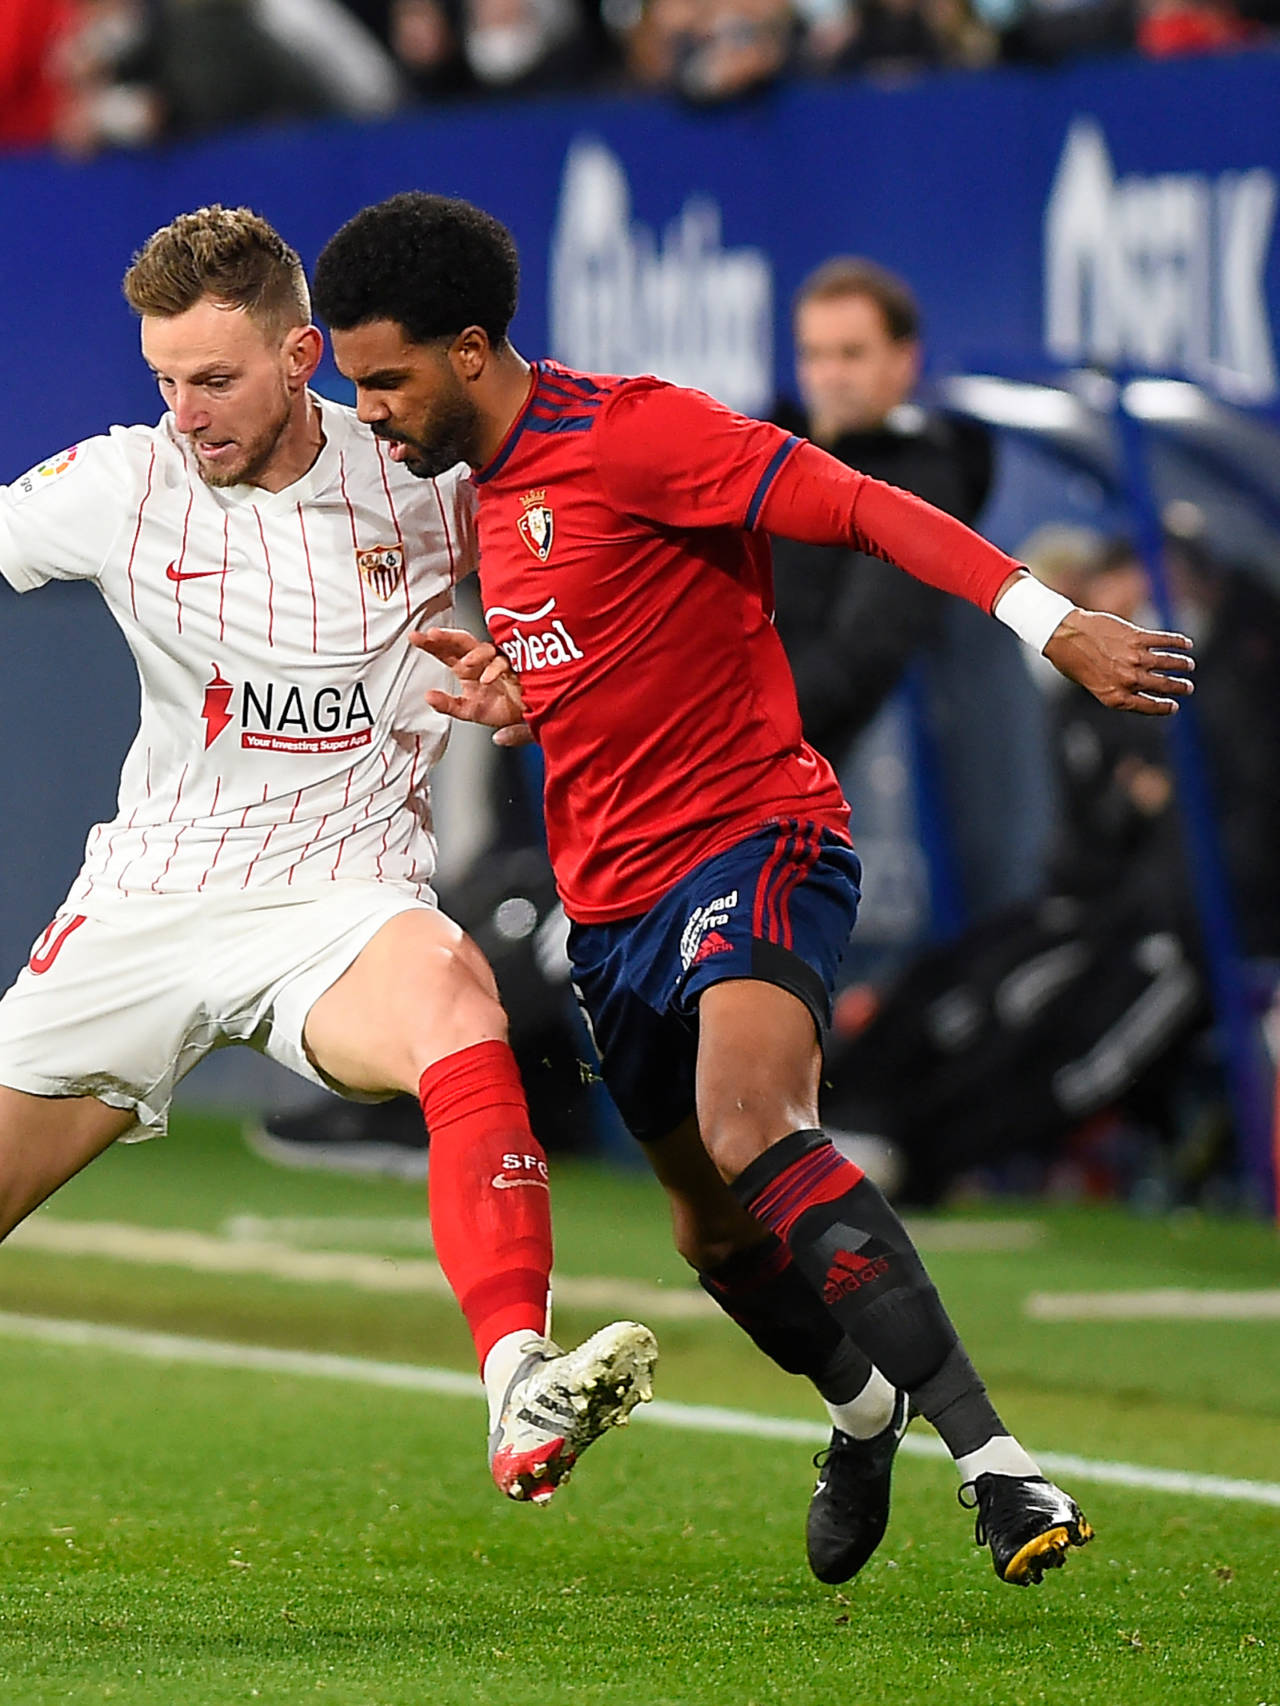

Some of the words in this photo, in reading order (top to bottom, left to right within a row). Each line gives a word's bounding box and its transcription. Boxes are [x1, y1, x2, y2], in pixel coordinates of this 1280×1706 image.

[241, 681, 375, 733] NAGA
[247, 735, 271, 748] Your
[272, 738, 319, 752] Investing
[320, 740, 349, 751] Super
[349, 735, 368, 747] App
